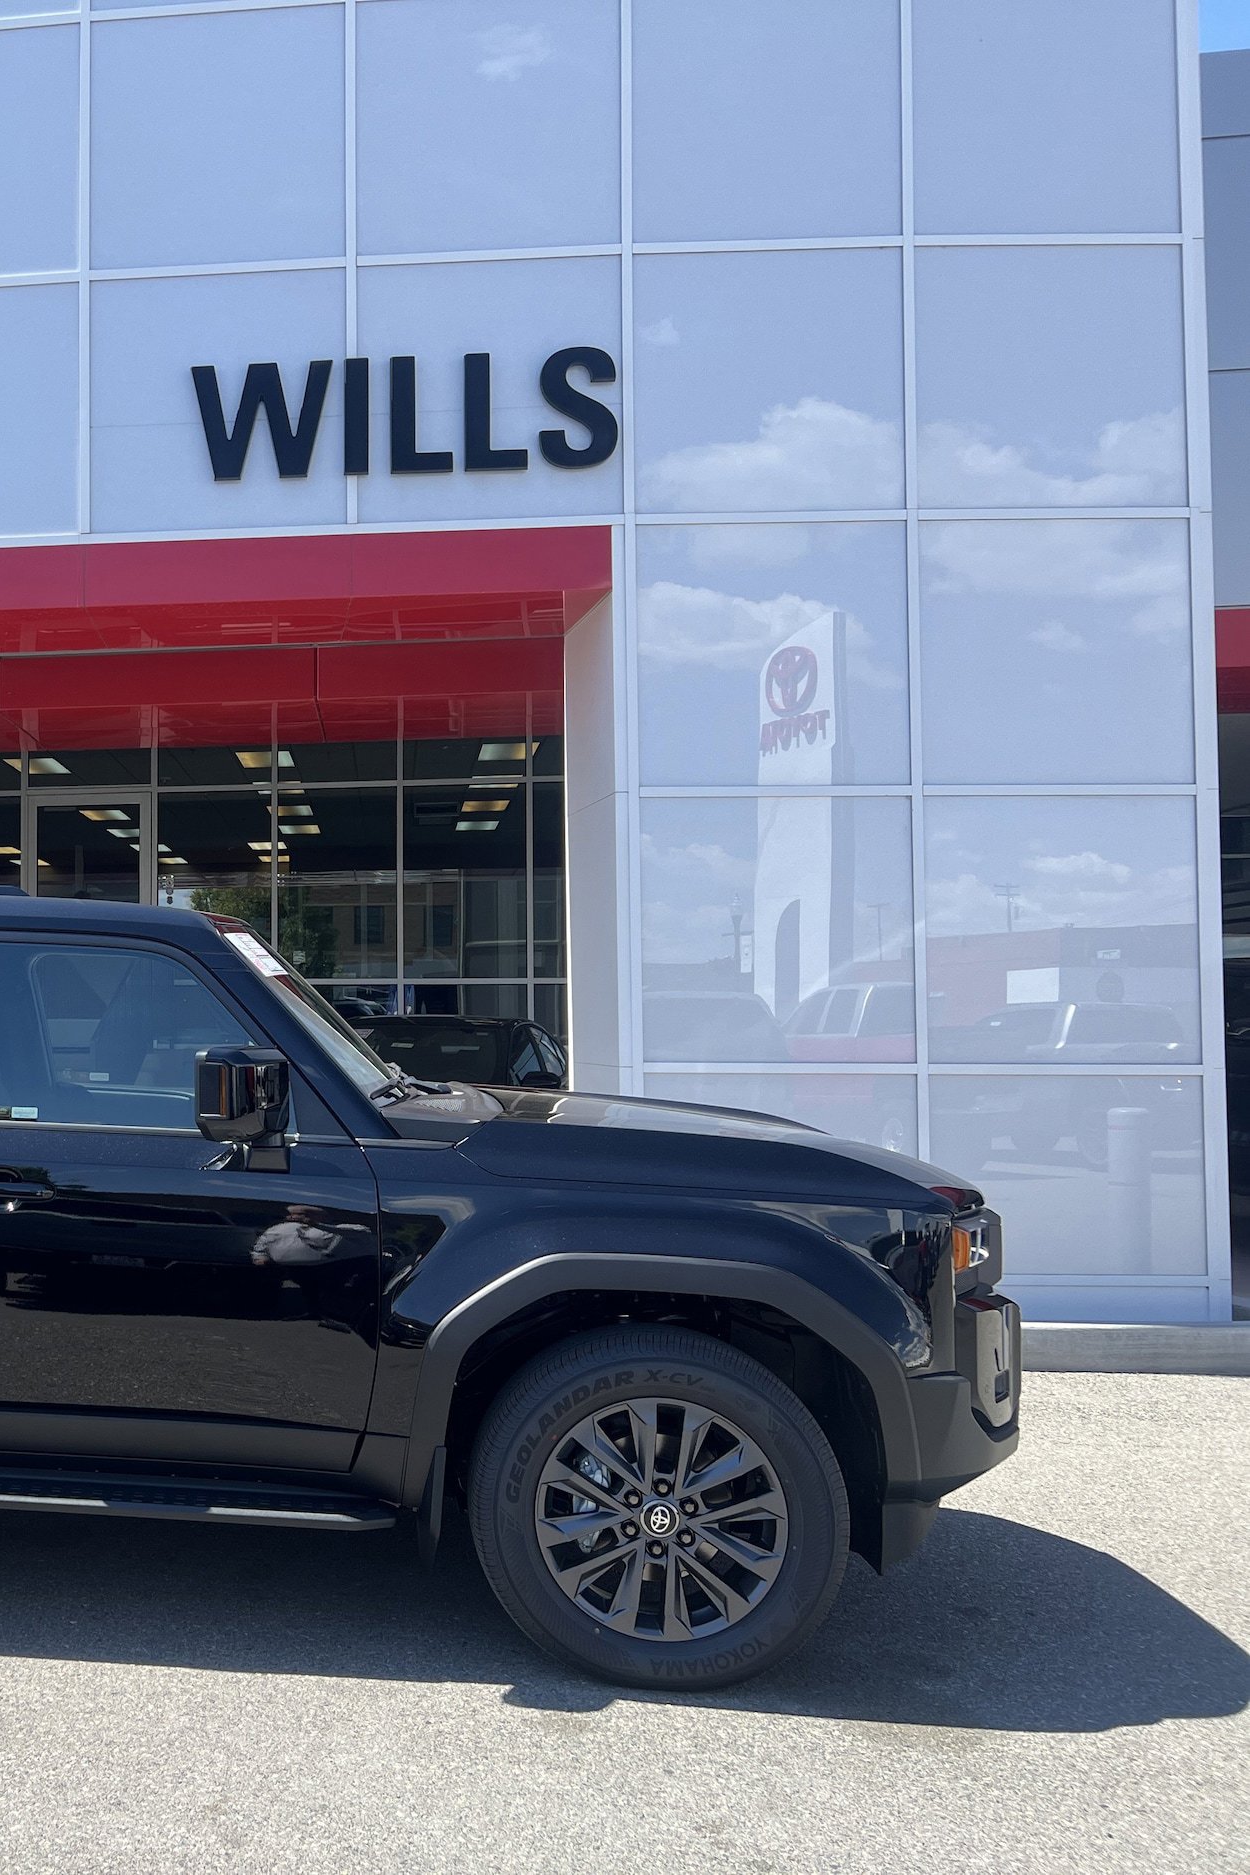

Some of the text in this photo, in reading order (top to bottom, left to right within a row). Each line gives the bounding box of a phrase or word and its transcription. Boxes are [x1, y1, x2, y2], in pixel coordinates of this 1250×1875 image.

[191, 346, 619, 481] WILLS
[508, 1368, 703, 1502] GEOLANDAR X-CV
[651, 1638, 768, 1677] YOKOHAMA
